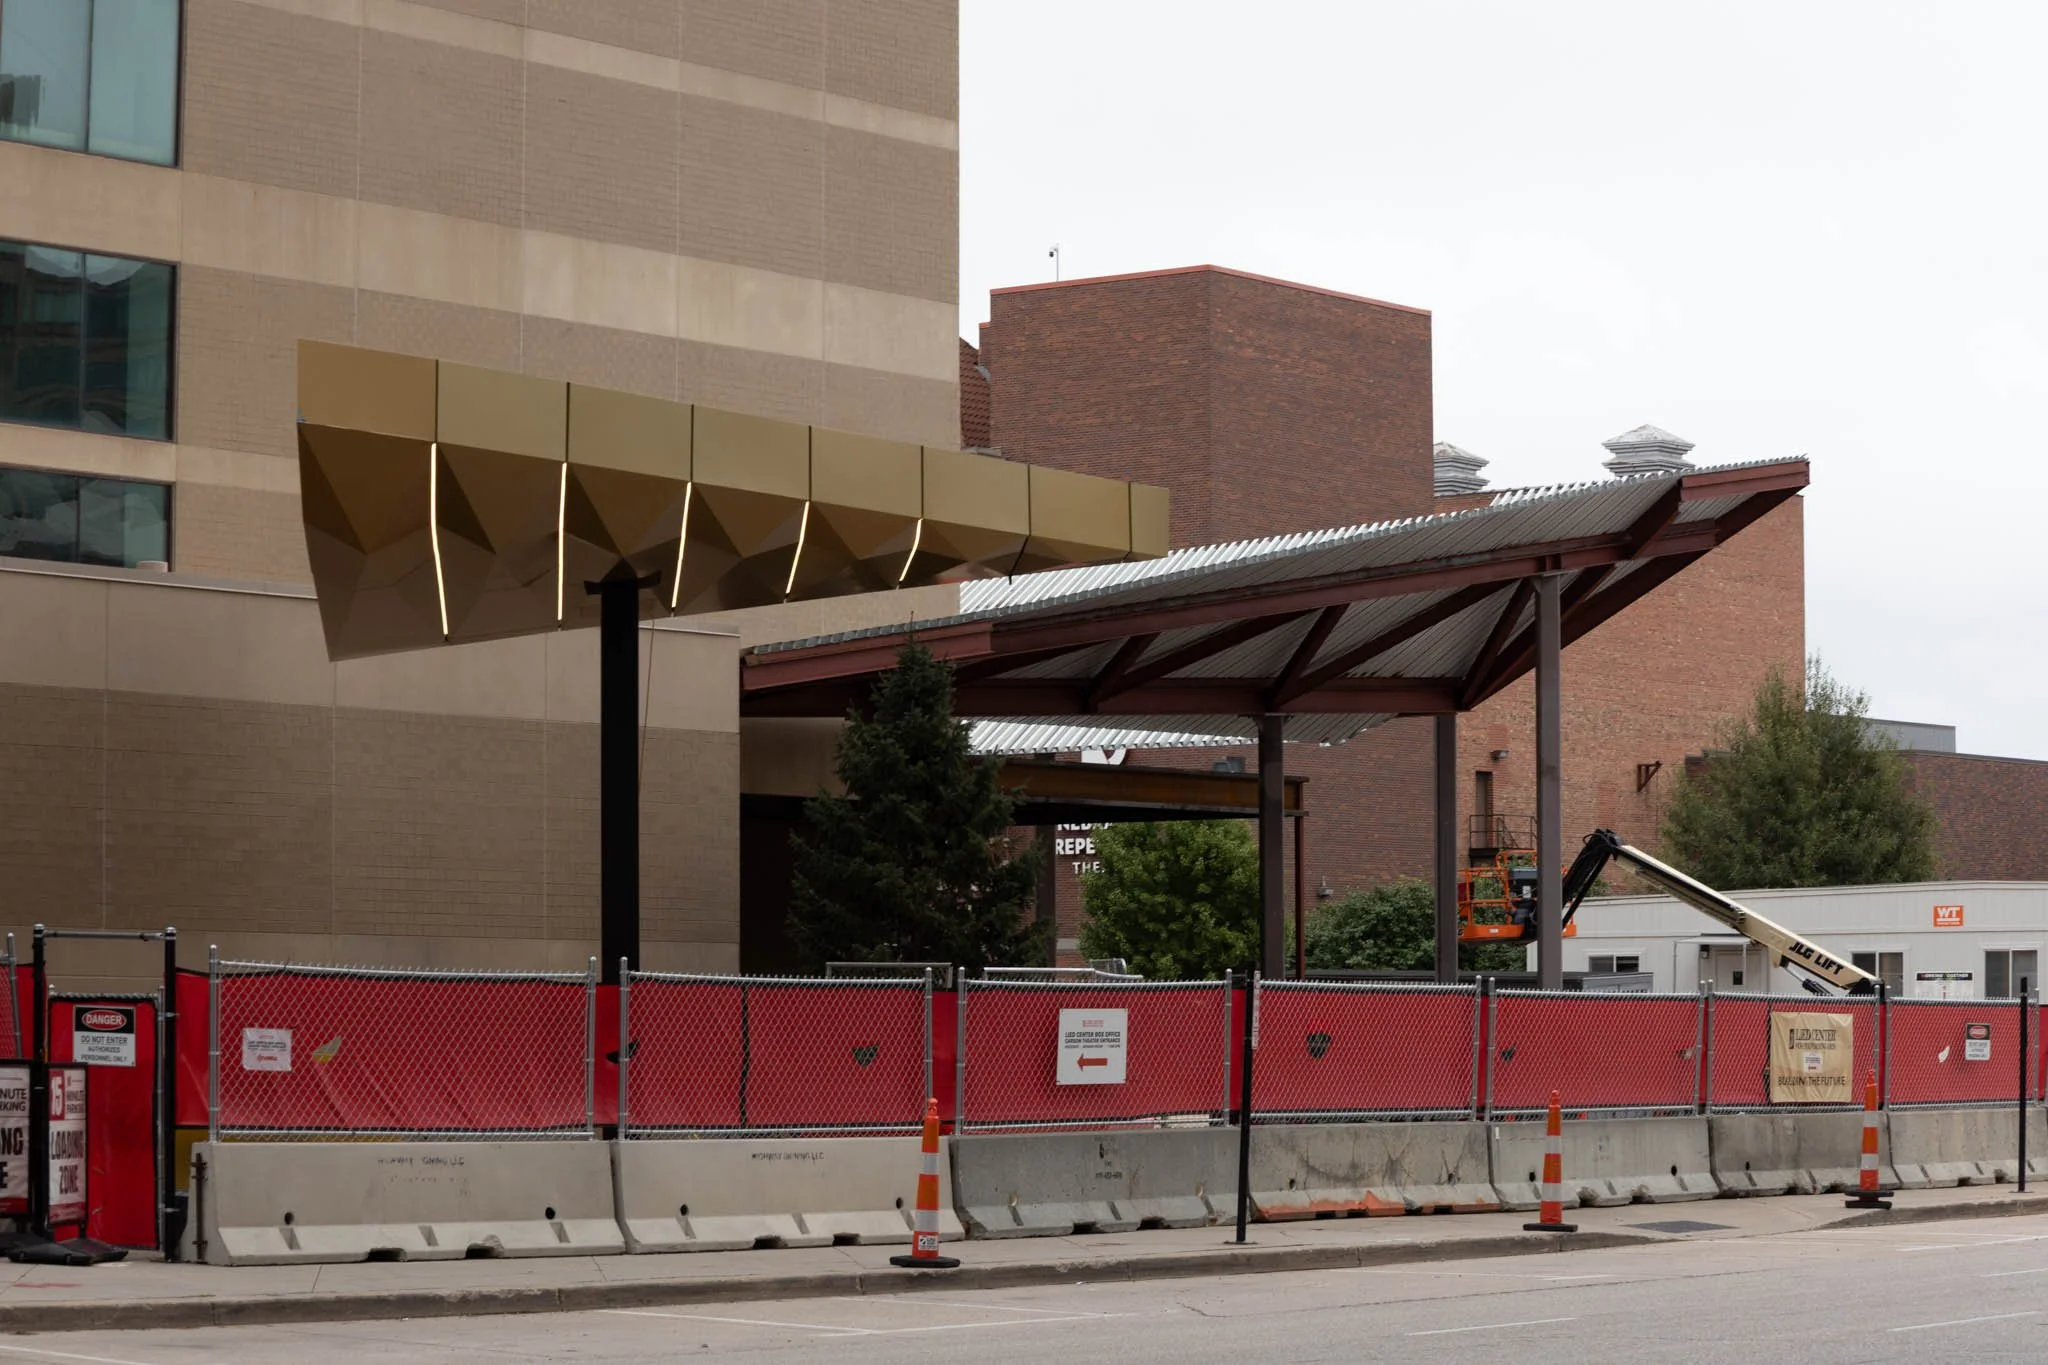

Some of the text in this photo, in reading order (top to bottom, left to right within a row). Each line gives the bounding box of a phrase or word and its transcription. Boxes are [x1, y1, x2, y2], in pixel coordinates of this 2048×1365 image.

[1056, 838, 1096, 855] REPE
[1072, 861, 1101, 875] THE
[1936, 907, 1960, 918] WT
[1789, 941, 1845, 975] JLG LIFT
[86, 1014, 123, 1025] DANGER
[80, 1034, 128, 1046] DO NOT ENTER
[1821, 1076, 1846, 1086] FUTURE
[0, 1088, 27, 1100] NUTE
[51, 1075, 64, 1117] 15
[0, 1101, 27, 1112] KING
[50, 1130, 84, 1161] LOADING
[58, 1165, 79, 1195] ZONE
